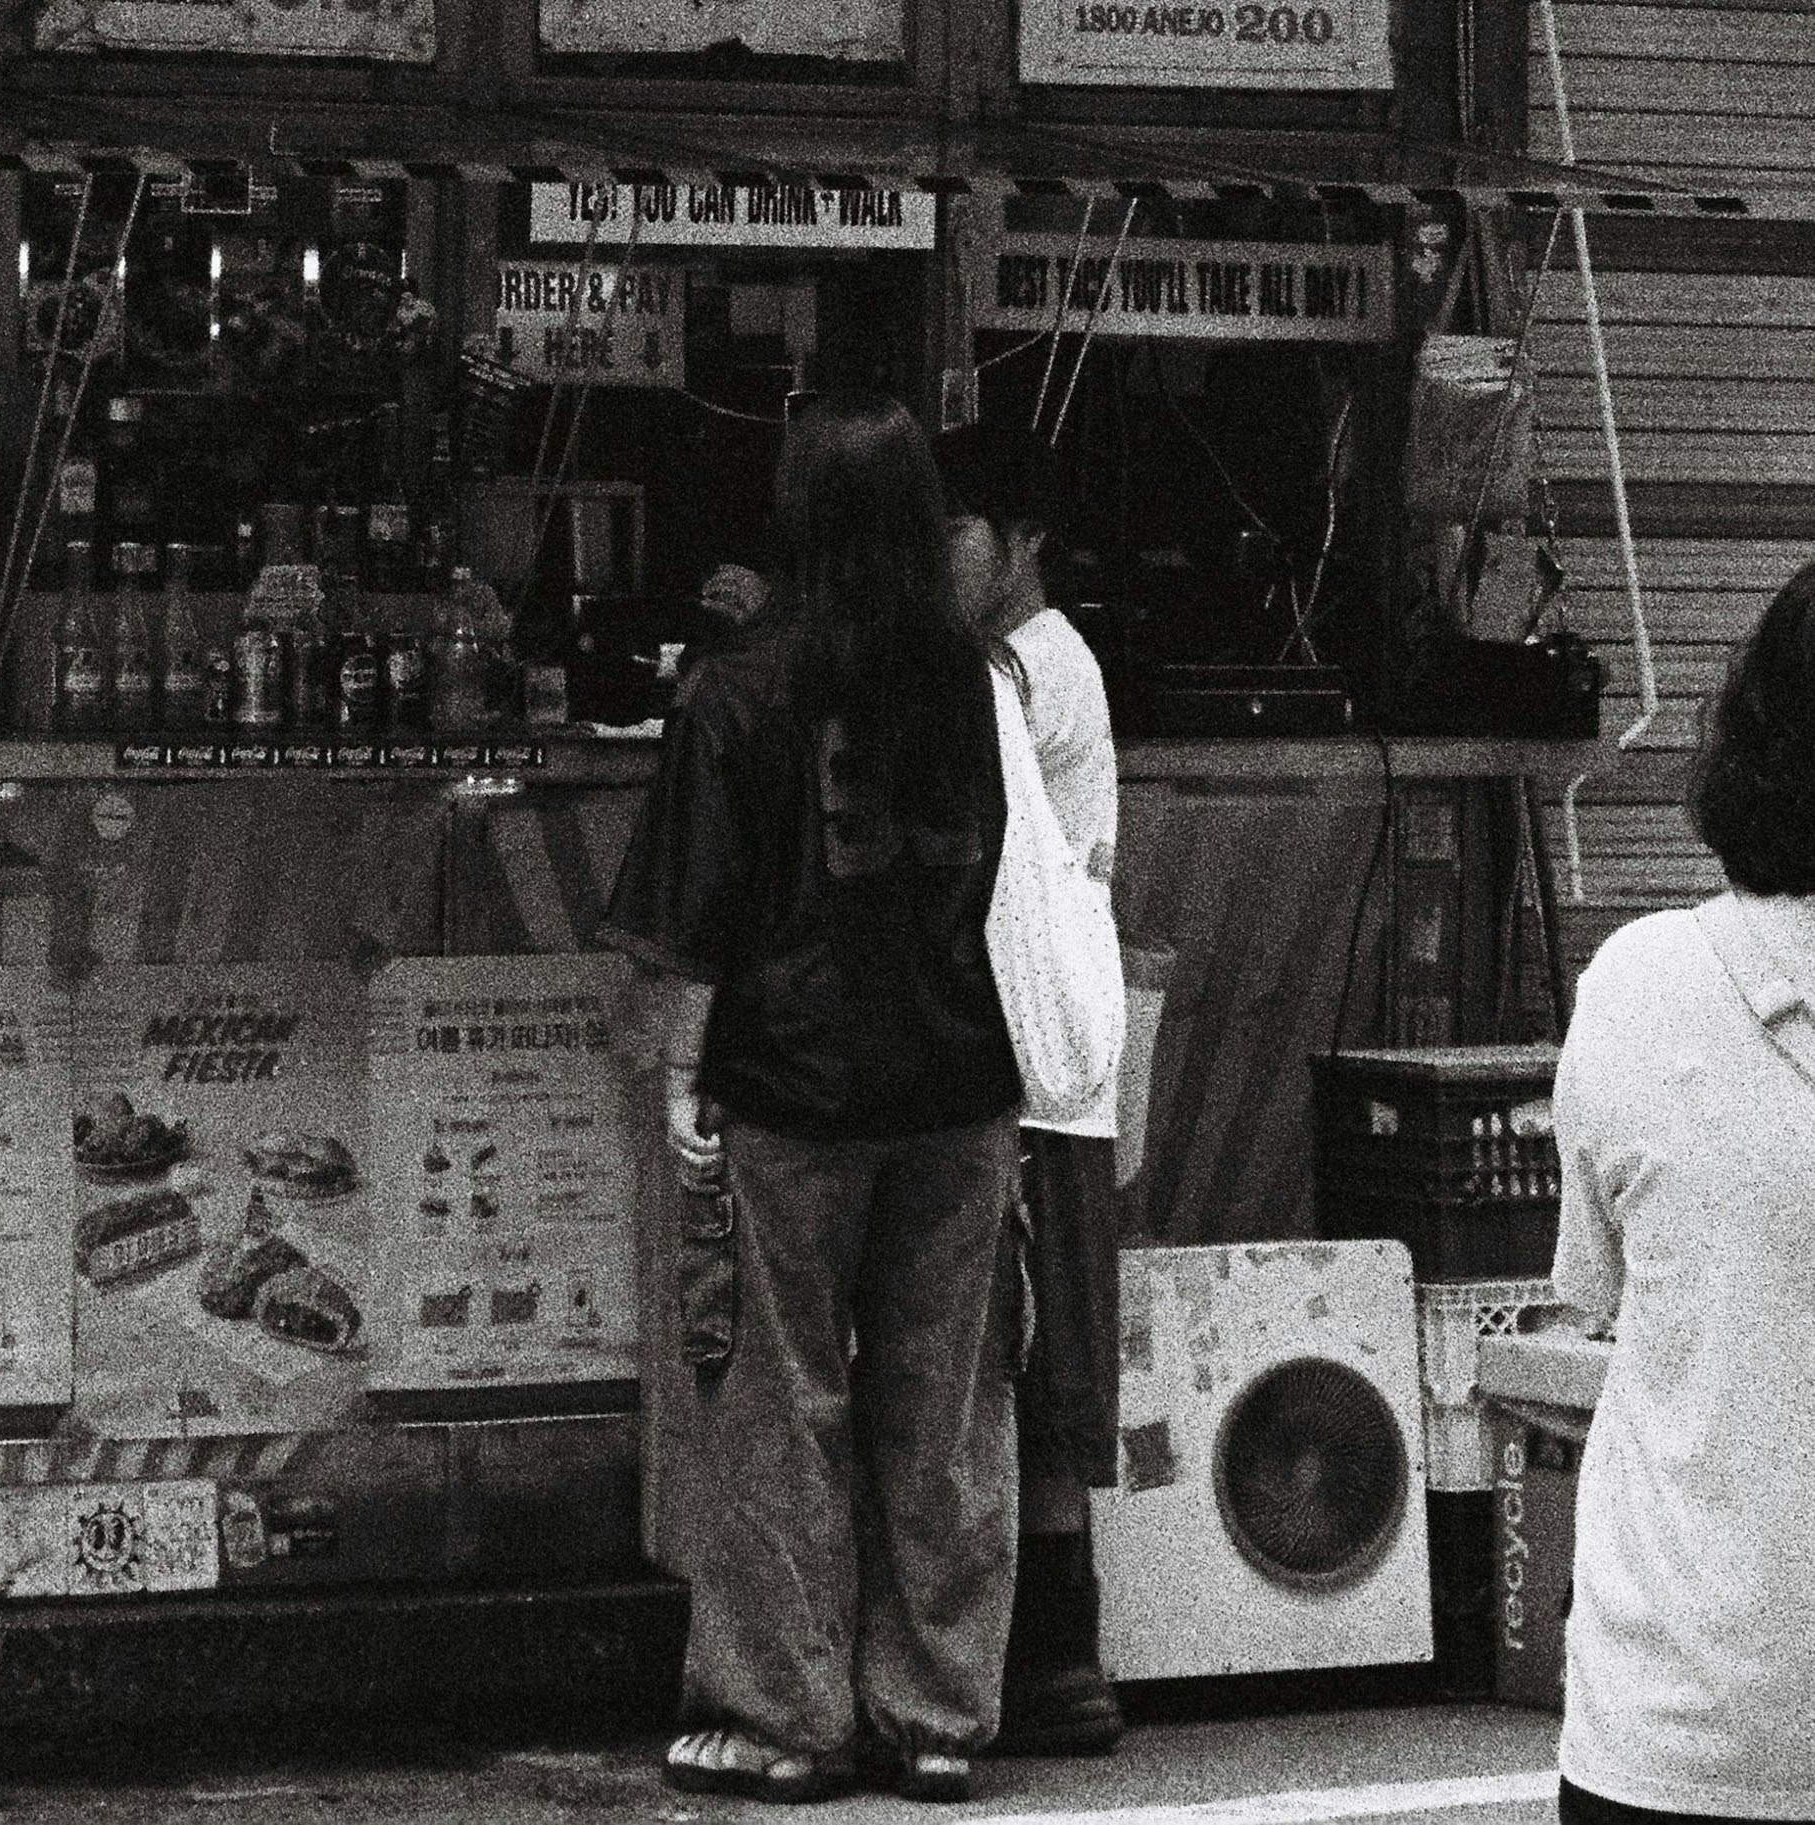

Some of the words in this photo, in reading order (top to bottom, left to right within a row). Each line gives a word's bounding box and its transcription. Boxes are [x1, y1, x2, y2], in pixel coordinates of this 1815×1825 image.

[1074, 4, 1137, 35] 1800
[689, 184, 735, 224] CAN
[747, 185, 818, 226] DRINK
[838, 188, 904, 228] WALK
[587, 271, 605, 313] &
[620, 272, 671, 316] PAY
[997, 253, 1050, 309] BEST
[1056, 256, 1113, 313] TACO
[1118, 258, 1190, 315] YOU'LL
[1195, 260, 1252, 316] TAKE
[1258, 262, 1298, 318] ALL
[1304, 264, 1351, 320] DAY
[544, 326, 615, 370] HERE
[142, 1012, 300, 1049] MEXICAN
[161, 1049, 280, 1084] FIESTA
[1499, 1442, 1529, 1652] recycle
